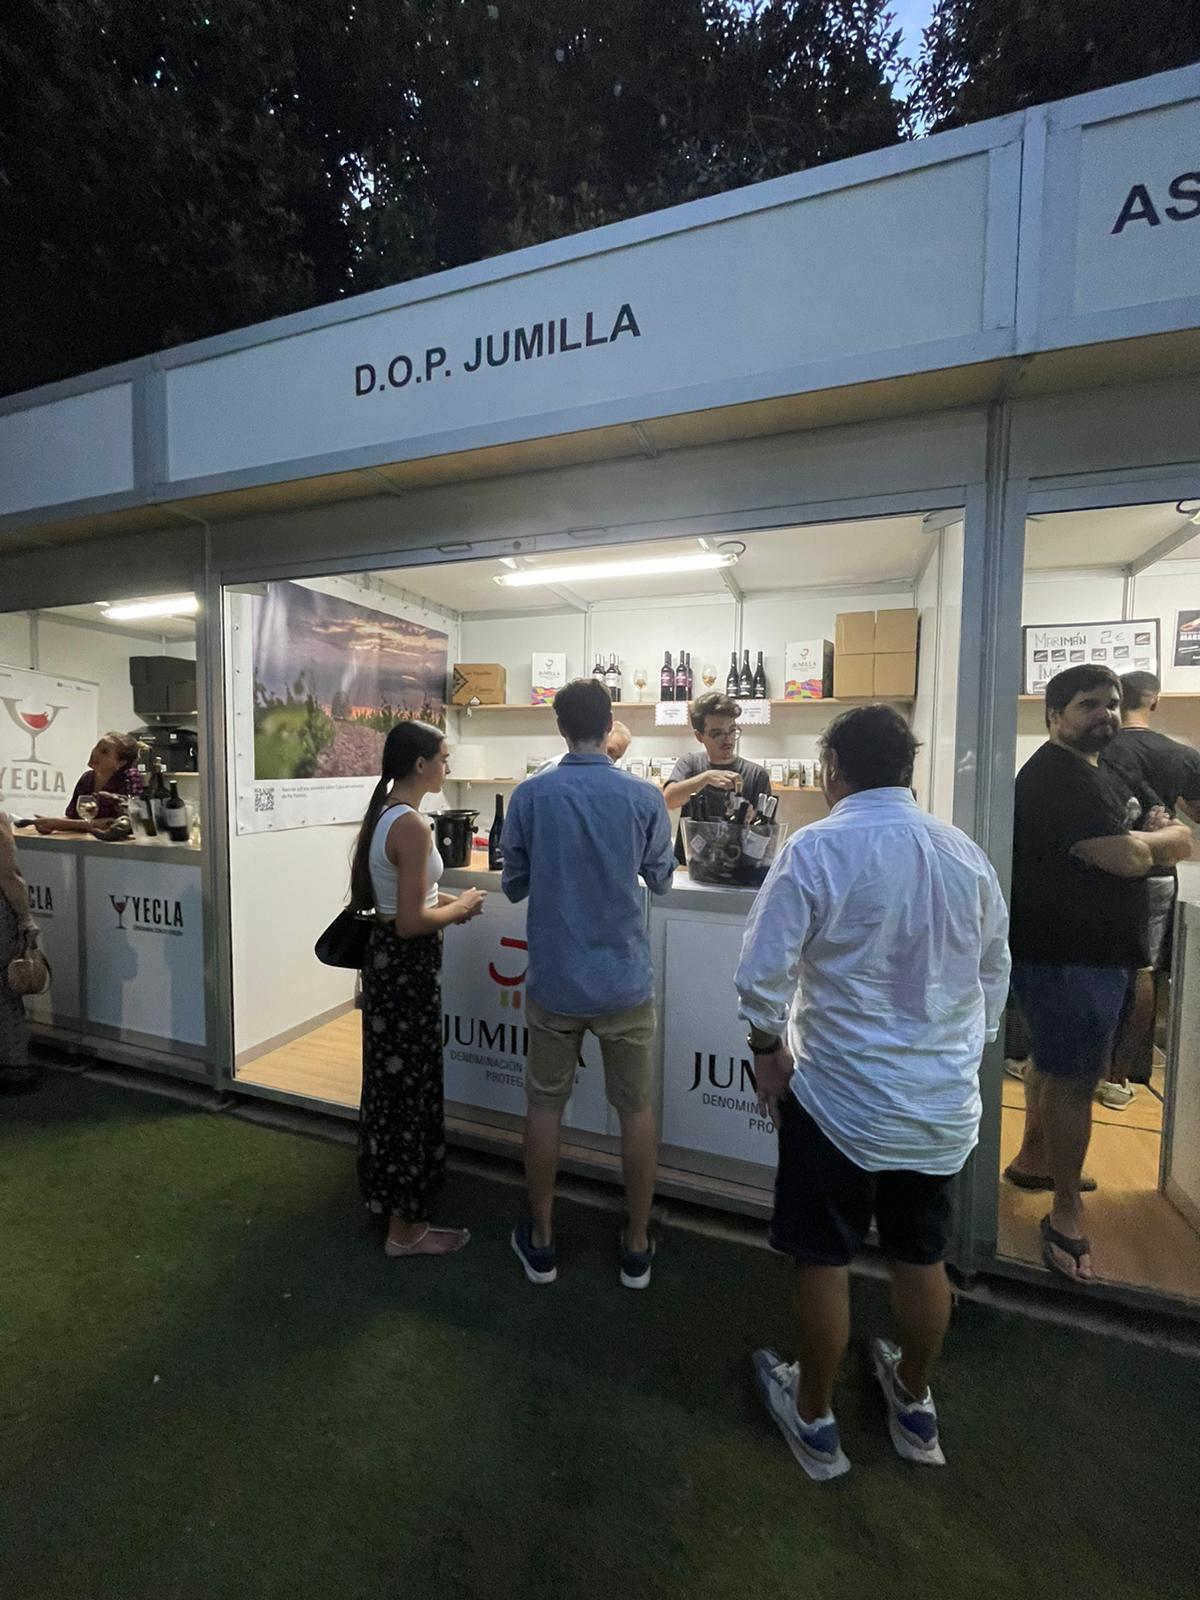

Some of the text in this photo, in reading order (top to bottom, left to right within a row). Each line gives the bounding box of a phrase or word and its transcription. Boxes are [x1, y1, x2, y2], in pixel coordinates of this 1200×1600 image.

[354, 303, 642, 396] D.O.P. JUMILLA
[131, 896, 184, 927] YECLA
